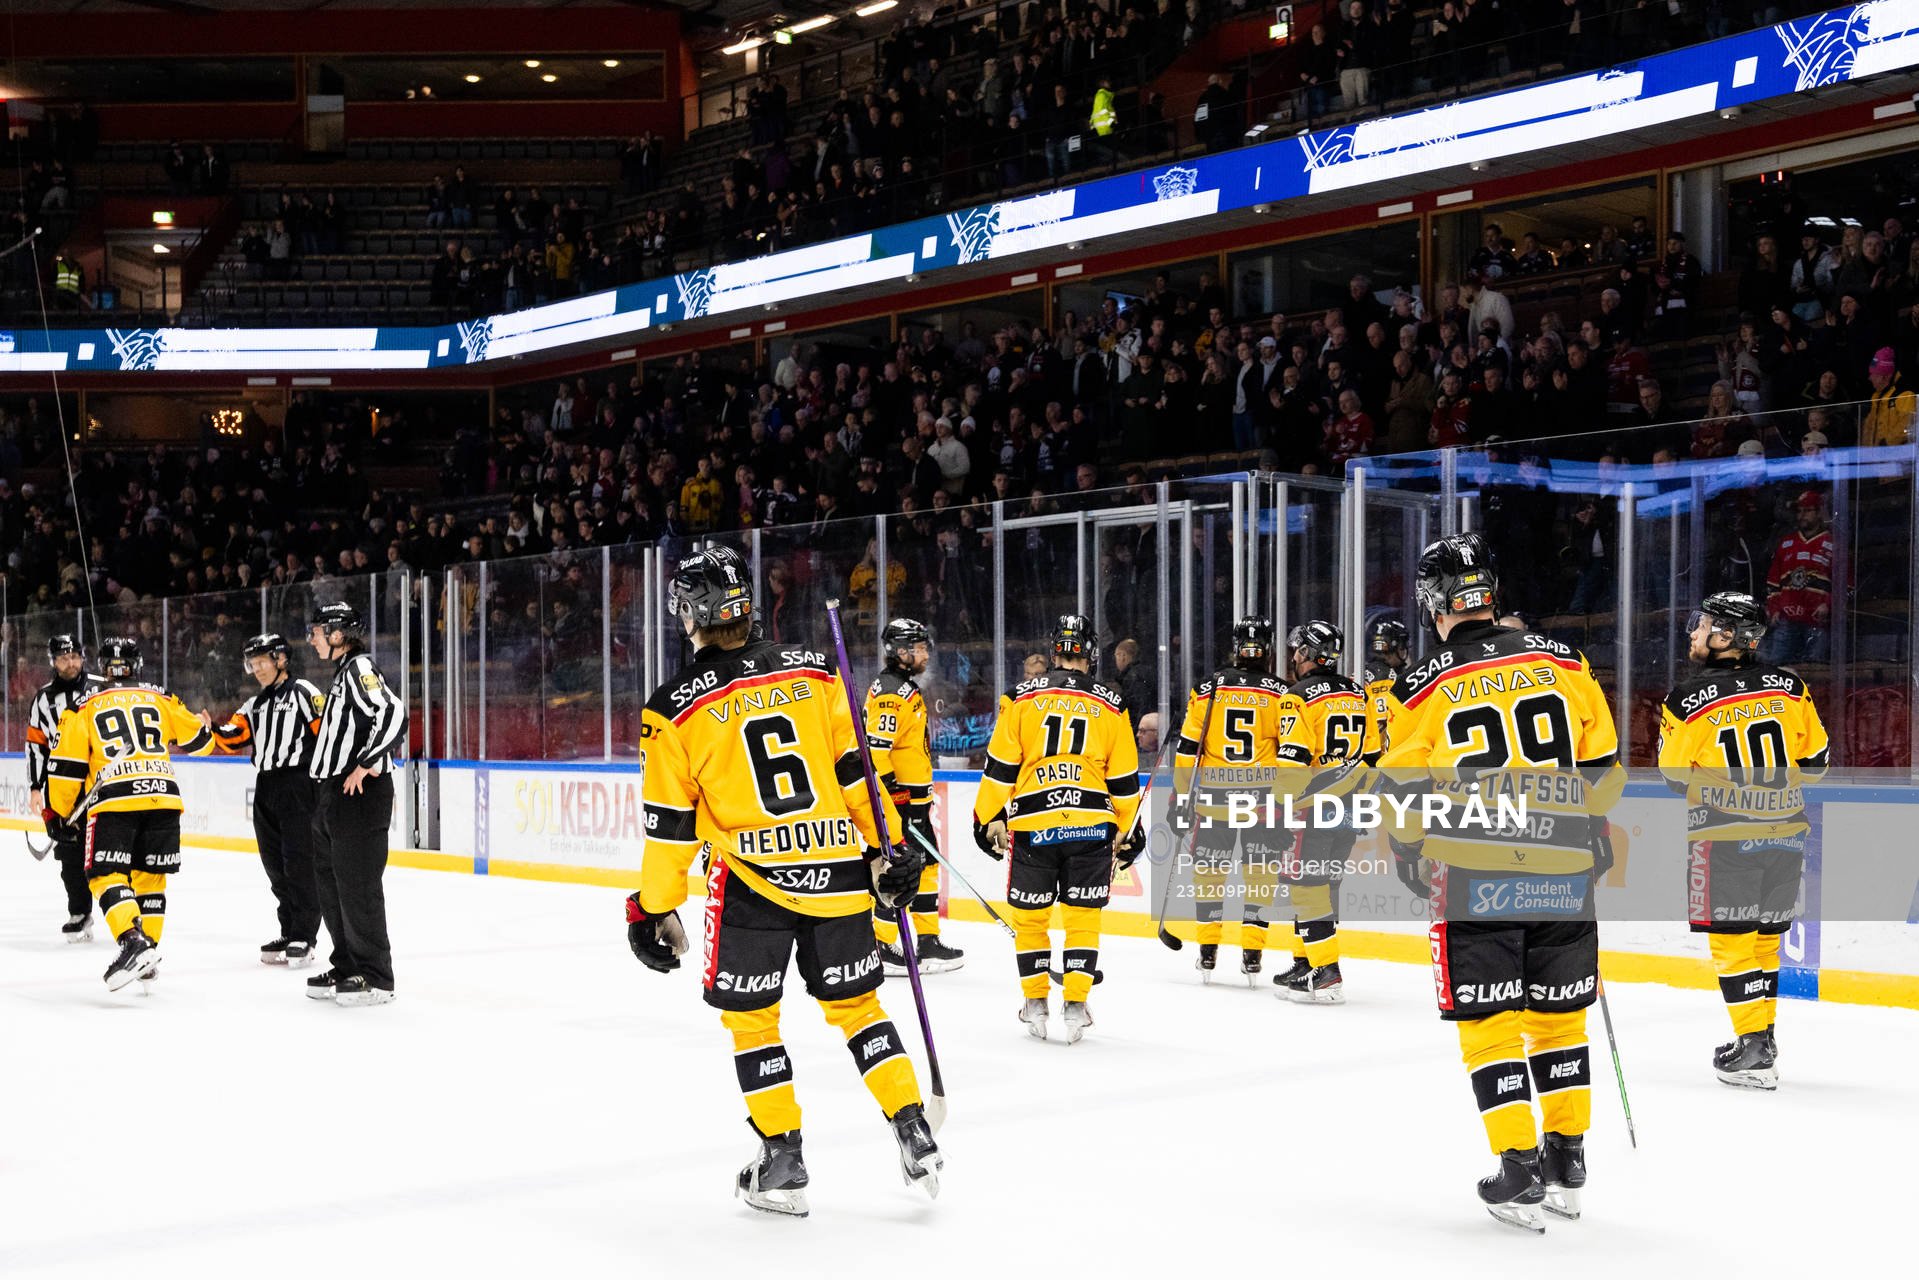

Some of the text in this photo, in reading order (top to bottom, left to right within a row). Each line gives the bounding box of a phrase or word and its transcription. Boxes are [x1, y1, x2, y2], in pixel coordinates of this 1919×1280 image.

[733, 602, 741, 617] 6
[1465, 591, 1482, 609] 29
[1063, 641, 1071, 651] 11
[1523, 634, 1571, 655] SSAB
[780, 649, 826, 667] SSAB
[1405, 651, 1454, 691] SSAB
[670, 669, 719, 709] SSAB
[1016, 677, 1049, 694] SSAB
[1200, 676, 1225, 694] SSB
[1261, 677, 1288, 695] SSAB
[1306, 682, 1331, 699] SSAB
[1762, 674, 1794, 692] SSAB
[1092, 684, 1122, 705] SSAB
[1681, 684, 1718, 713] SSAB
[94, 703, 167, 761] 96
[878, 713, 897, 733] 39
[1040, 712, 1088, 758] 11
[1223, 707, 1257, 763] 5
[1325, 713, 1366, 760] 67
[1443, 690, 1577, 782] 29
[1716, 716, 1791, 790] 10
[740, 711, 817, 820] 6
[1036, 763, 1082, 784] PASIC
[132, 780, 168, 794] SSAB
[513, 778, 645, 840] SOLKEDJA
[1046, 789, 1082, 808] SSAB
[738, 818, 858, 856] HEDQVIST
[1057, 827, 1106, 840] Consulting
[1485, 813, 1556, 840] SSAB
[105, 851, 132, 865] LKAB
[156, 852, 181, 866] LKAB
[766, 867, 831, 890] SSAB
[1515, 881, 1572, 897] Student
[1019, 892, 1053, 905] LKAB
[1080, 885, 1109, 900] LKAB
[1345, 893, 1402, 915] PART
[1514, 896, 1584, 911] Consulting
[1729, 904, 1760, 921] LKAB
[843, 949, 880, 983] LKAB
[1066, 958, 1087, 969] NEX
[734, 971, 782, 993] LKAB
[1477, 978, 1524, 1004] LKAB
[1548, 975, 1595, 1002] LKAB
[1744, 978, 1765, 995] NEX
[863, 1034, 891, 1061] NEX
[759, 1055, 787, 1077] NEX
[1549, 1058, 1584, 1080] NEX
[1497, 1073, 1524, 1095] NEX
